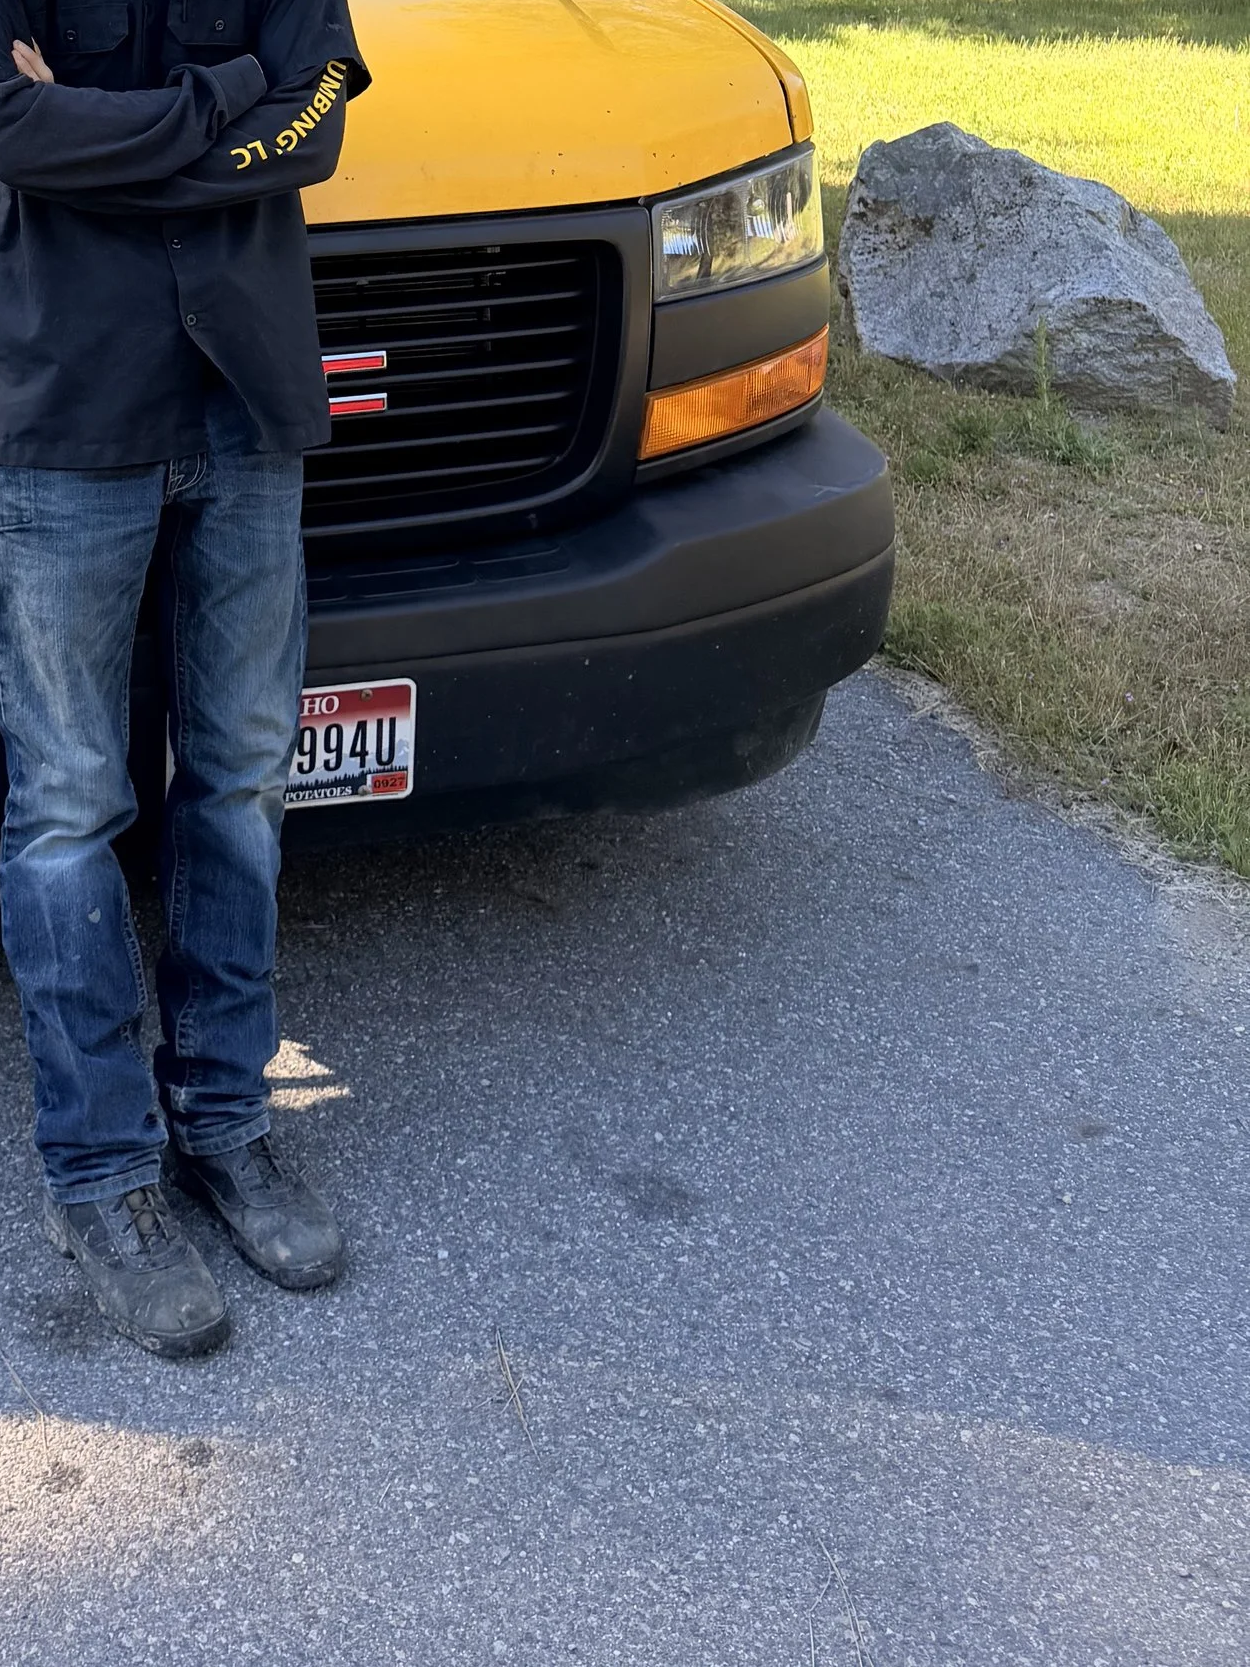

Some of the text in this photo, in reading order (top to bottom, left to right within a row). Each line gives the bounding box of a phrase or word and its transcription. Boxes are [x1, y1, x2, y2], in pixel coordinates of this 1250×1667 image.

[230, 140, 283, 169] LC
[296, 717, 397, 775] 994U
[285, 786, 352, 802] POTATOES
